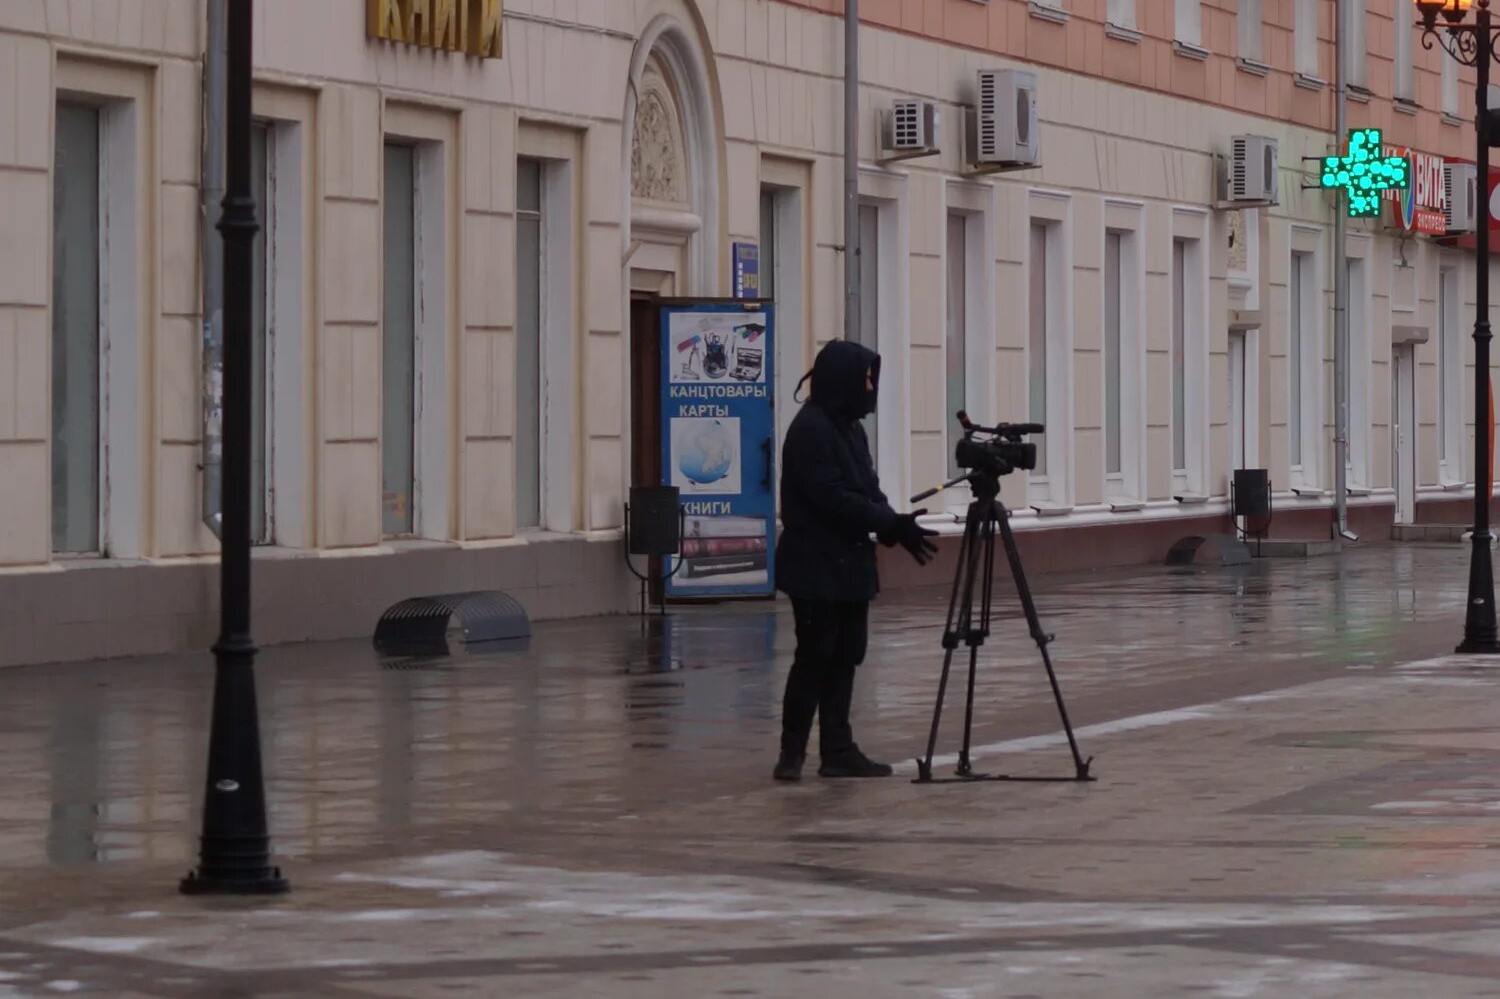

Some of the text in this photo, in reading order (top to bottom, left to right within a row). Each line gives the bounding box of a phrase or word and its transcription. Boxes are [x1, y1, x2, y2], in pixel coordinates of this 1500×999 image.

[1416, 153, 1447, 210] ВИТА
[1416, 212, 1446, 232] ЭКСПРЕСС
[669, 385, 767, 399] КАНЦТОВАРЫ
[679, 404, 729, 417] КАРТЫ
